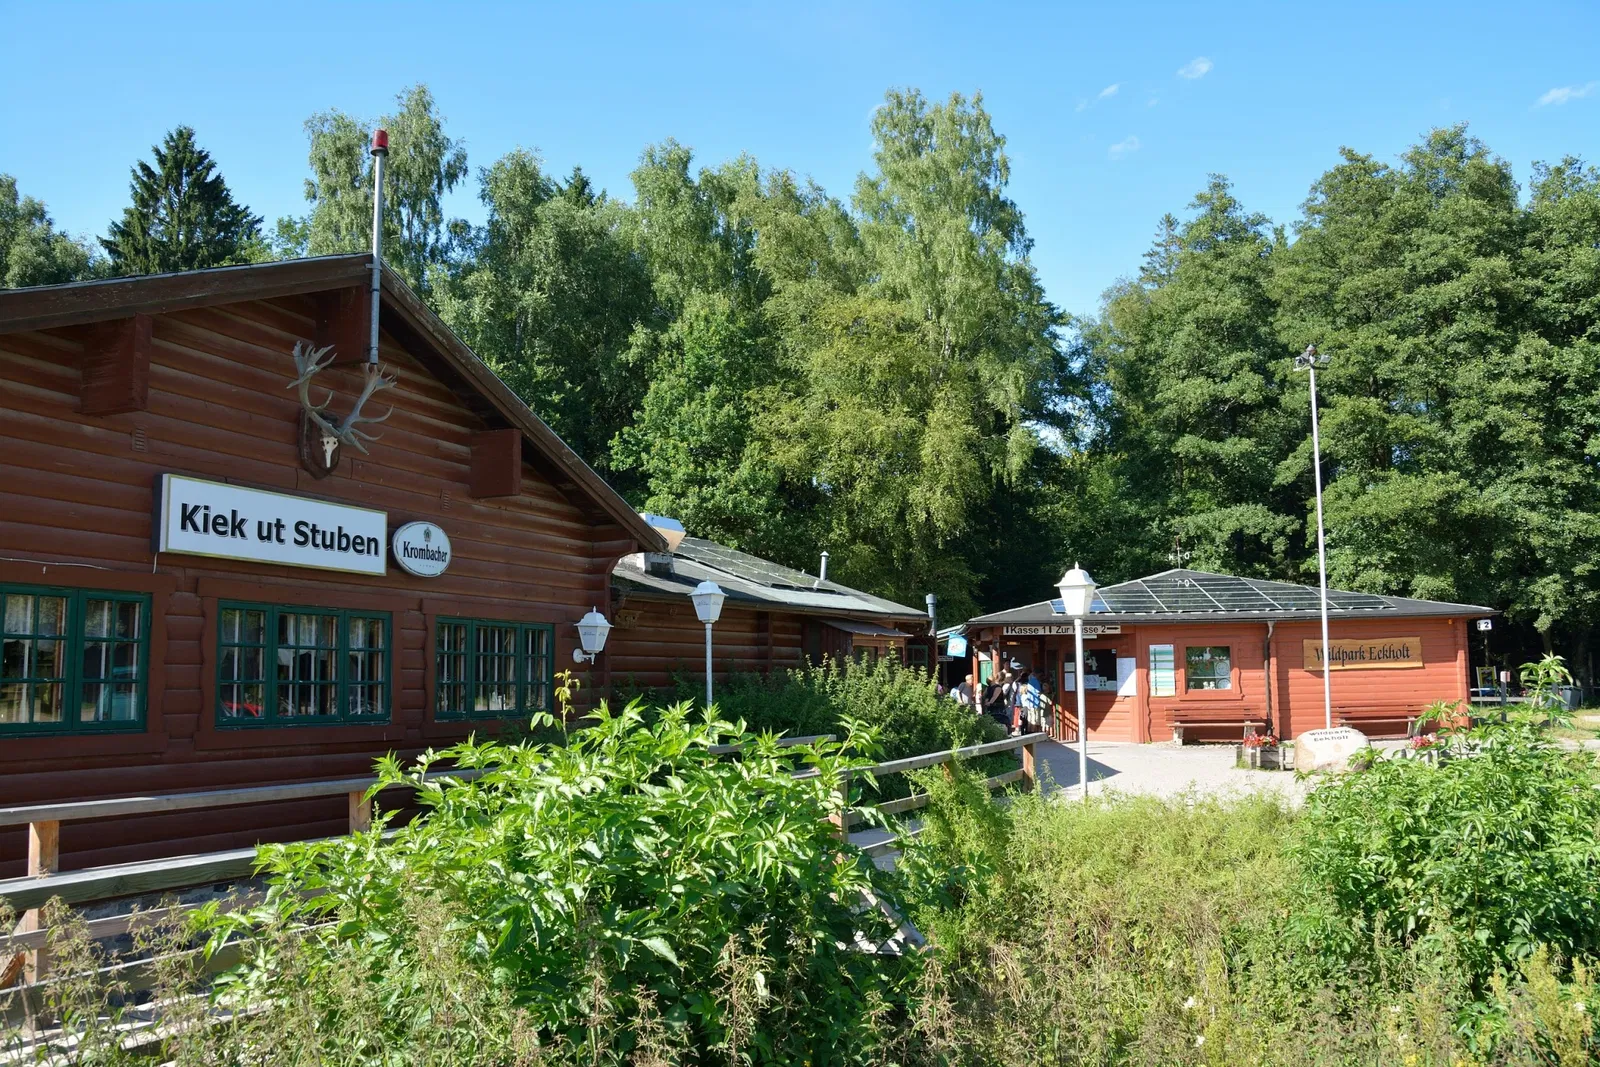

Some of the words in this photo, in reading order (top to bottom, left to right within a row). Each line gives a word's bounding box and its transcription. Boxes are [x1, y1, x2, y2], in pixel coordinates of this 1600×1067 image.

[180, 503, 248, 539] Kiek
[257, 517, 286, 544] ut
[293, 520, 380, 557] Stuben
[402, 540, 448, 563] Krombacher
[1010, 625, 1039, 635] Kasse
[1055, 625, 1070, 634] Zur
[1101, 624, 1107, 634] 2
[1483, 621, 1489, 629] 2
[1314, 644, 1366, 667] Wildpark
